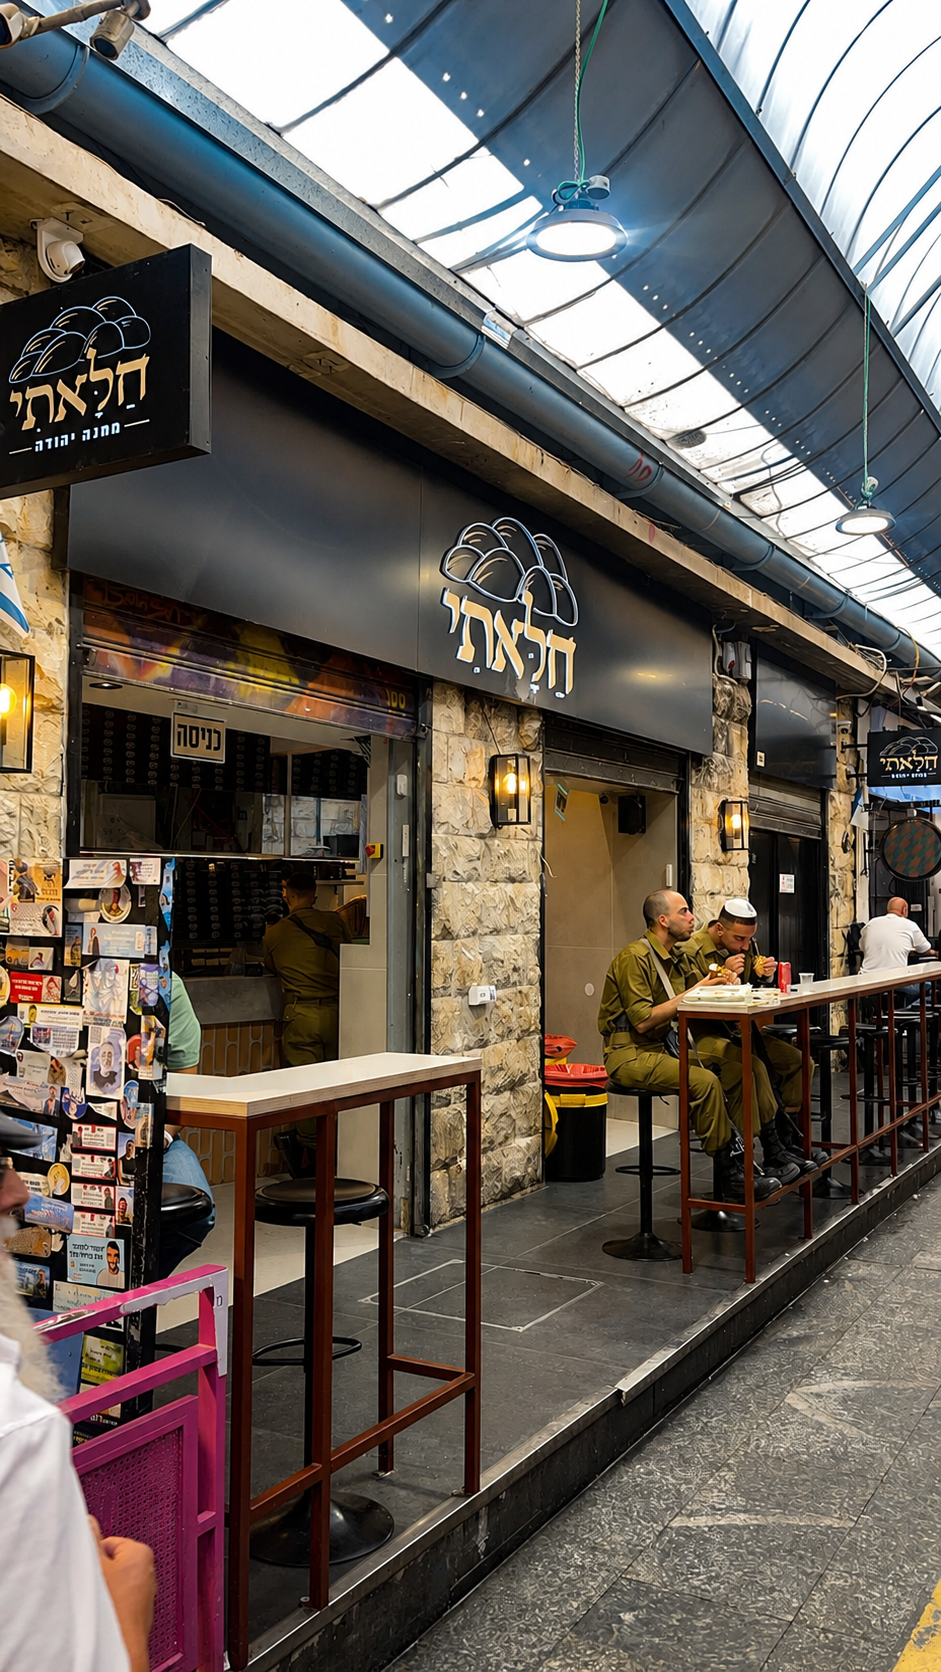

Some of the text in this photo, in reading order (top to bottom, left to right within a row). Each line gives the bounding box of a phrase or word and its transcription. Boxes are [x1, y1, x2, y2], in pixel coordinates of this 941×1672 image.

[34, 422, 121, 453] מחנה יהודה
[177, 723, 222, 751] כניסה
